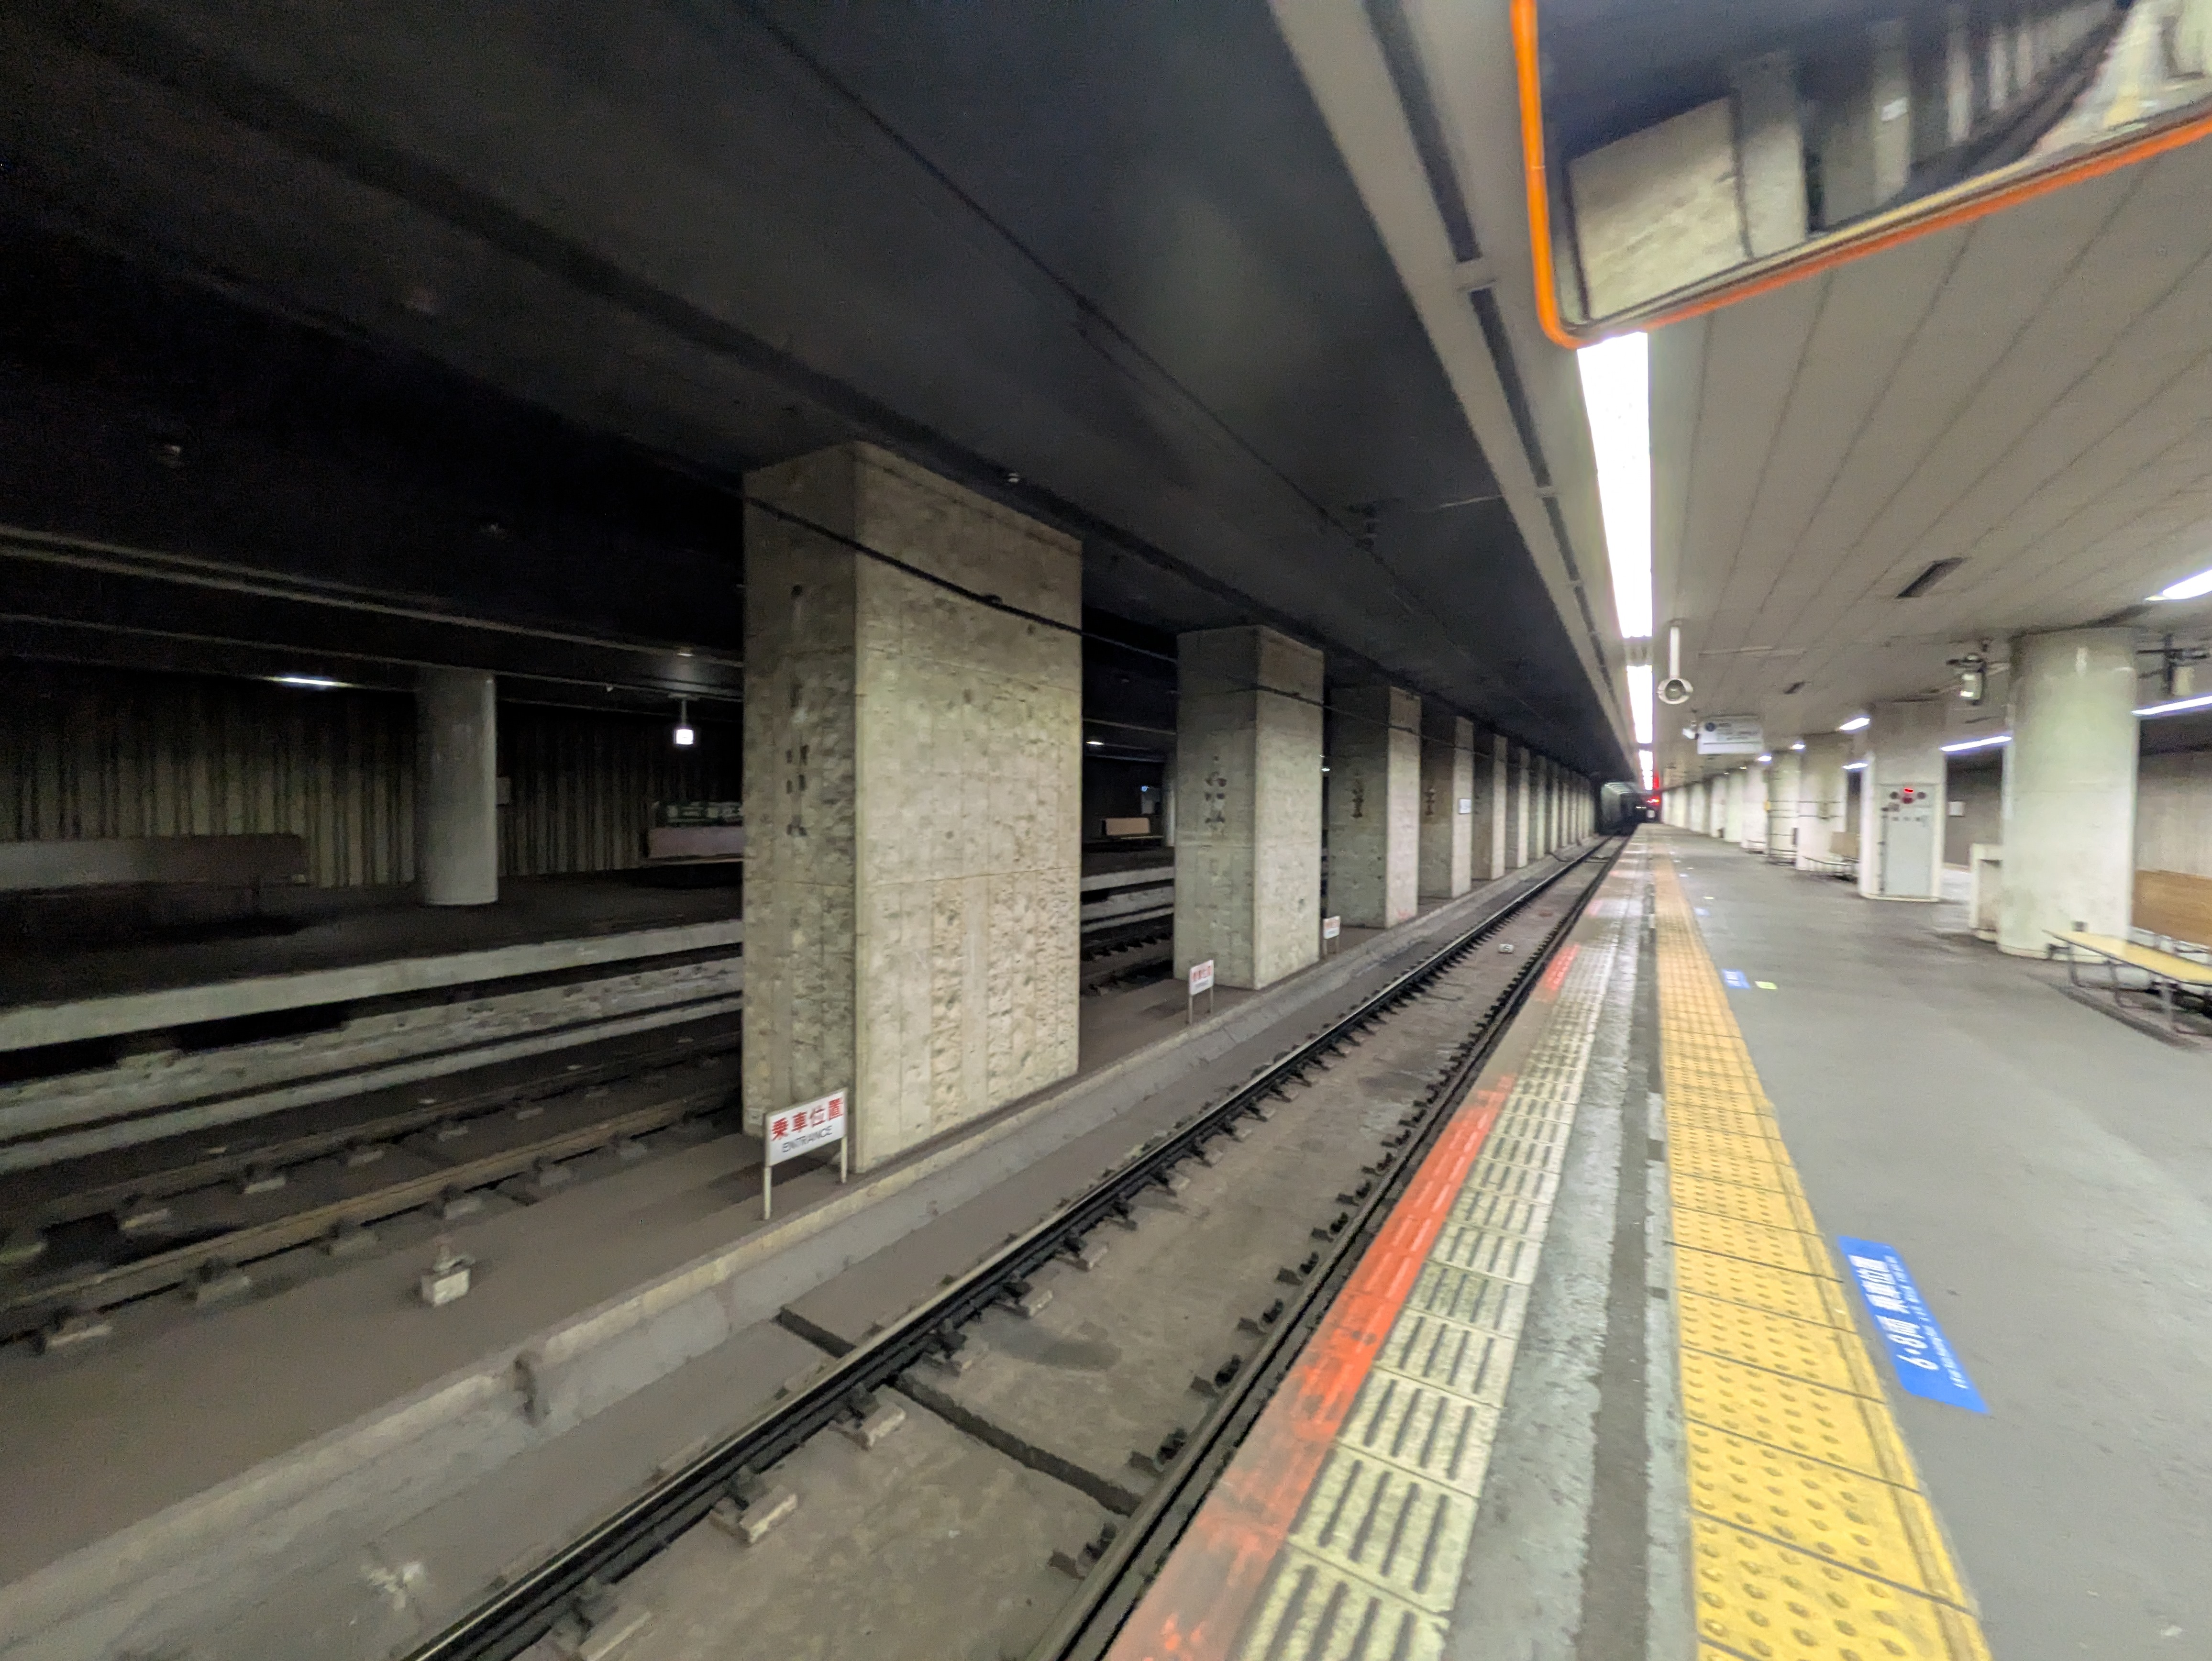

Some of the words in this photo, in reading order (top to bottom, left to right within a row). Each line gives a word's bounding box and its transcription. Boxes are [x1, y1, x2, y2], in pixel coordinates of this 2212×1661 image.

[771, 1097, 843, 1141] 乗車位置
[782, 1125, 833, 1153] ENTRANCE
